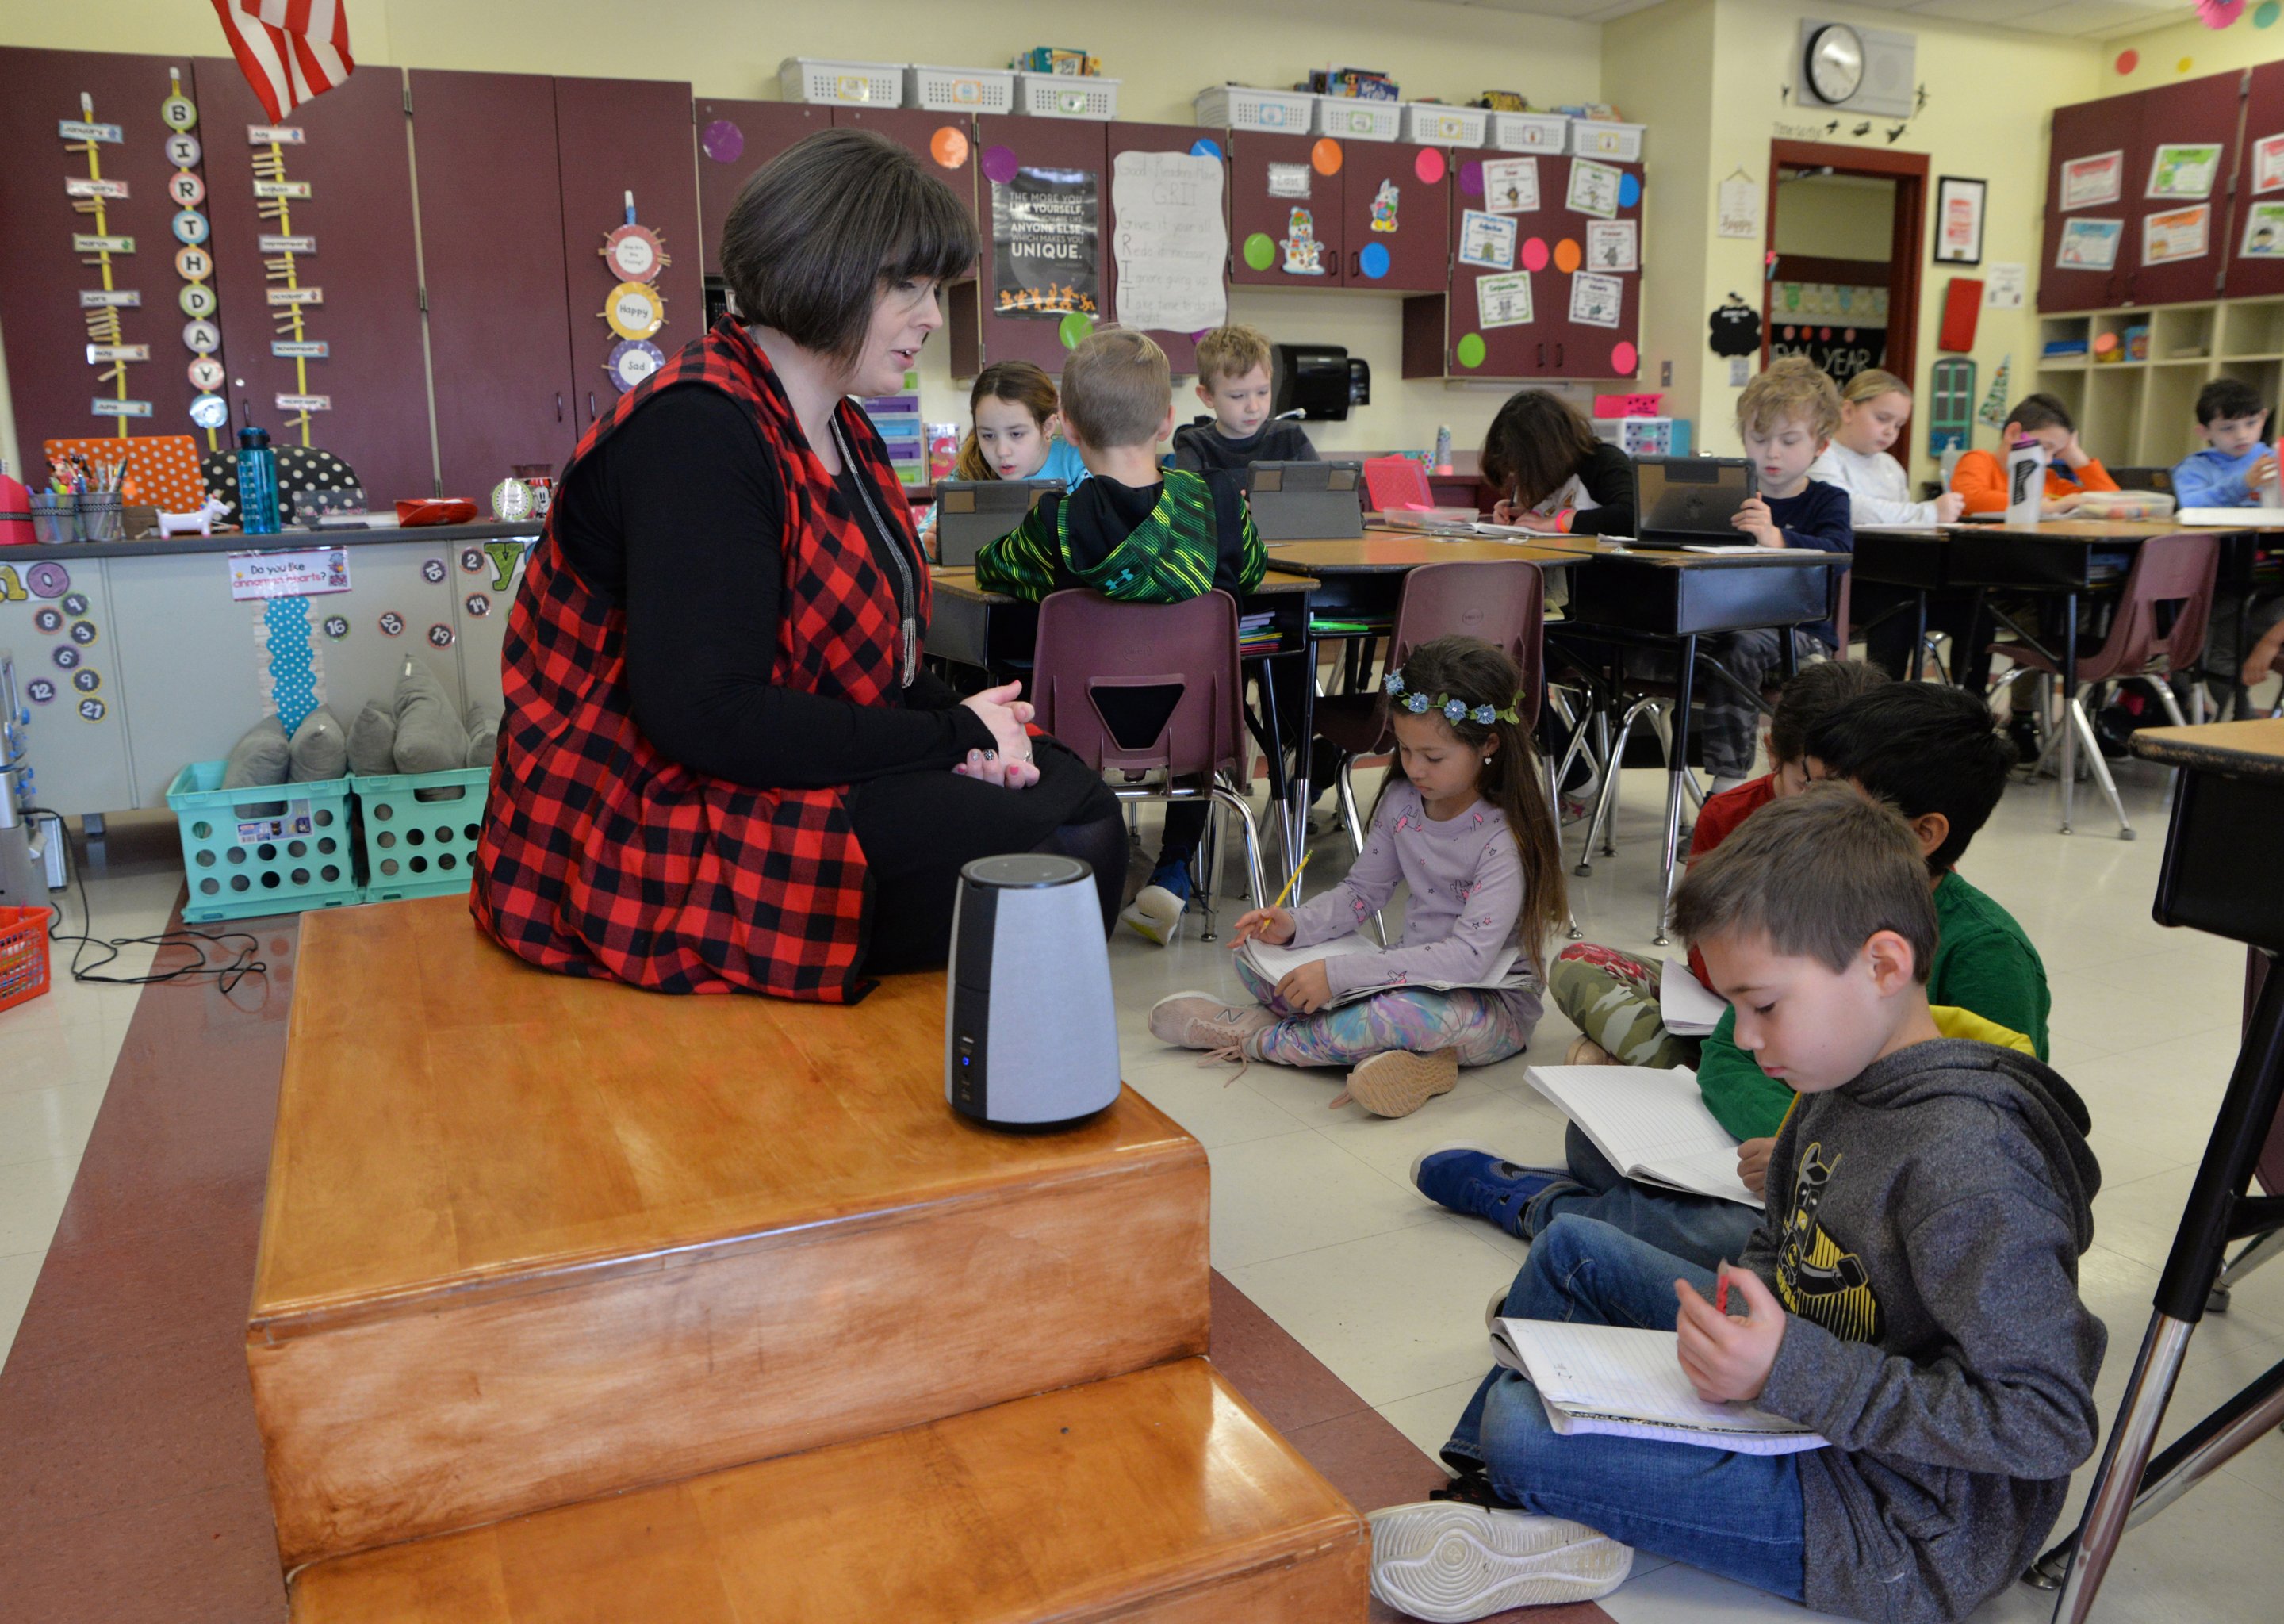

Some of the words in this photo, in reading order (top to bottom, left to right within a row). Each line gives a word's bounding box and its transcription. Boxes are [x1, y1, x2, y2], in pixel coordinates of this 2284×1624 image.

[1010, 192, 1028, 202] THE
[1031, 193, 1059, 204] MORE
[1063, 195, 1083, 205] YOU
[1152, 182, 1197, 206] GRIT
[1033, 203, 1084, 216] YOURSELF,
[1119, 208, 1150, 231] Give
[1011, 223, 1054, 233] ANYONE
[1011, 232, 1039, 242] WHICH
[1040, 235, 1066, 243] MAKES
[1067, 236, 1083, 244] YOU
[1122, 233, 1153, 257] Redo
[1011, 242, 1083, 259] UNIQUE.
[1195, 276, 1209, 287] up
[1121, 286, 1153, 310] Take
[1158, 297, 1178, 311] time
[1192, 298, 1205, 311] do
[619, 304, 649, 318] Happy
[627, 360, 646, 371] Sad
[1822, 346, 1872, 376] YEAR
[466, 554, 477, 568] 2
[251, 565, 264, 574] Do
[266, 564, 286, 575] you
[425, 562, 442, 580] 18
[67, 597, 82, 611] 4
[469, 596, 487, 612] 14
[43, 613, 56, 628] 8
[326, 619, 345, 635] 16
[380, 614, 402, 634] 20
[75, 626, 91, 640] 3
[431, 627, 450, 645] 19
[59, 650, 73, 665] 6
[80, 674, 93, 688] 9
[31, 684, 52, 699] 12
[82, 702, 103, 718] 21
[1214, 1008, 1244, 1025] N
